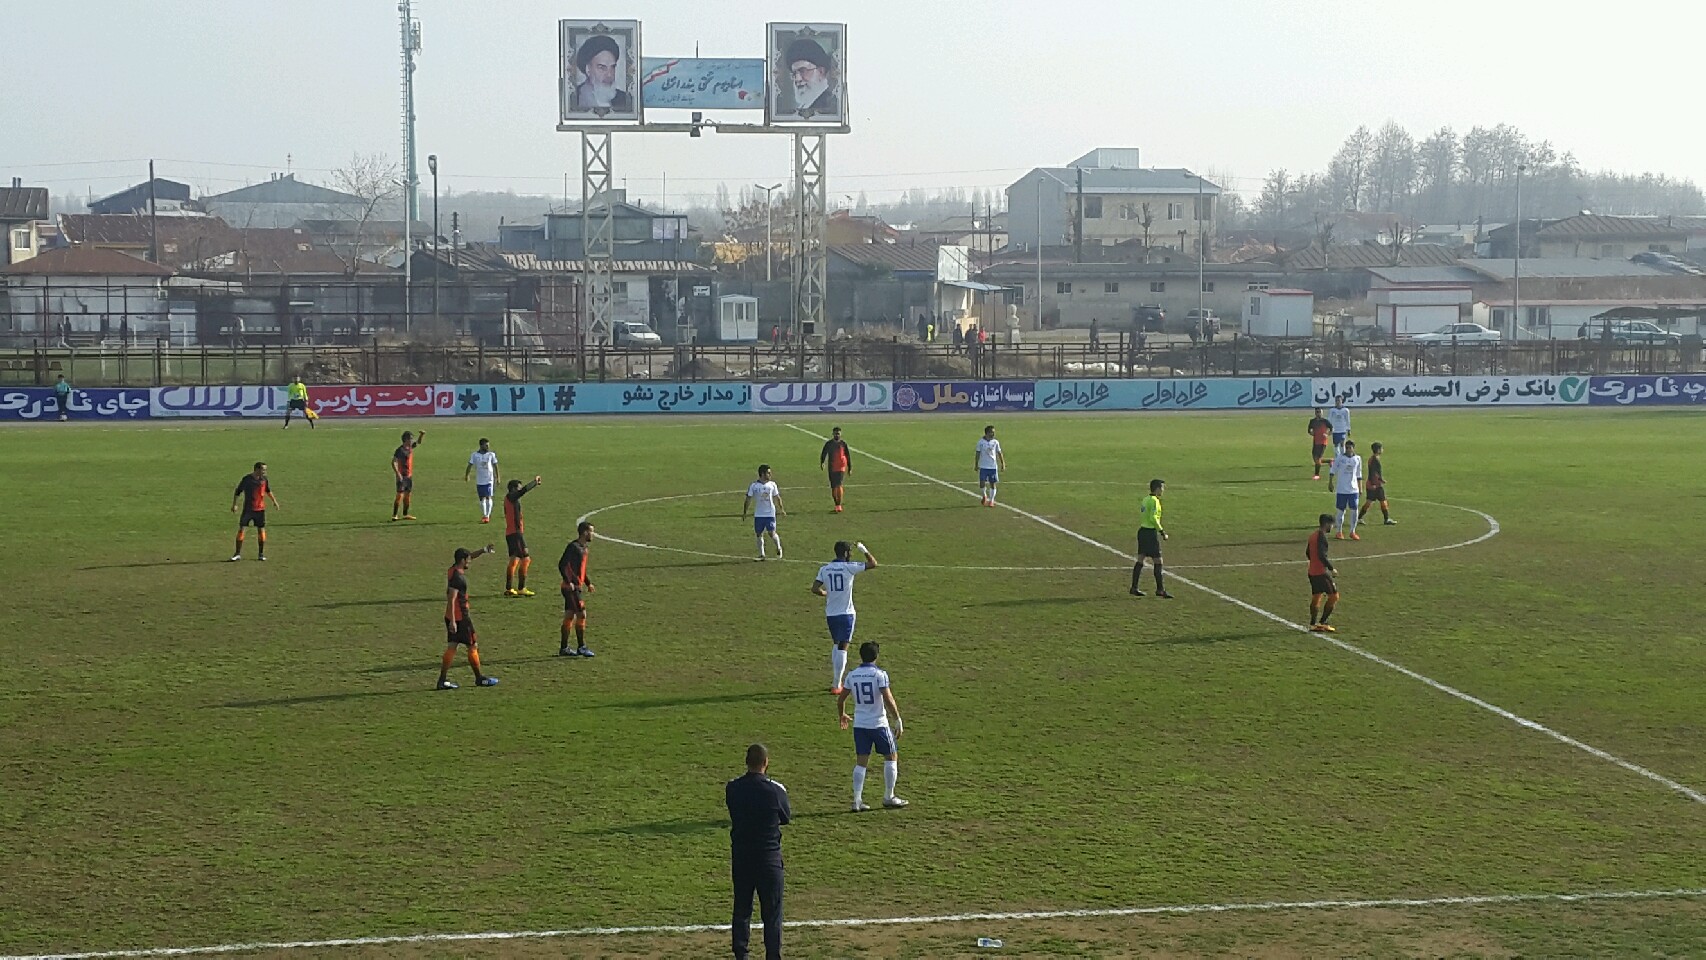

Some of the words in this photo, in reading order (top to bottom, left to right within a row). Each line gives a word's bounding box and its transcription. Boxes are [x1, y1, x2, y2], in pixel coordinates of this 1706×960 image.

[376, 386, 433, 406] لنت
[622, 385, 654, 406] نشو
[657, 385, 694, 410] خارج
[698, 385, 733, 406] مدار
[738, 385, 751, 405] از
[918, 384, 969, 411] ملل
[970, 385, 1003, 408] اعتباری
[1005, 386, 1034, 408] موسسه
[1315, 381, 1361, 404] ایران
[1366, 387, 1396, 404] مهر
[1401, 379, 1460, 398] الحسنه
[1466, 379, 1510, 403] قرض
[1516, 378, 1556, 401] بانک
[1590, 377, 1679, 404] نادری
[97, 392, 148, 416] چای
[314, 387, 372, 414] پارس
[827, 573, 844, 591] 10
[854, 682, 875, 704] 19
